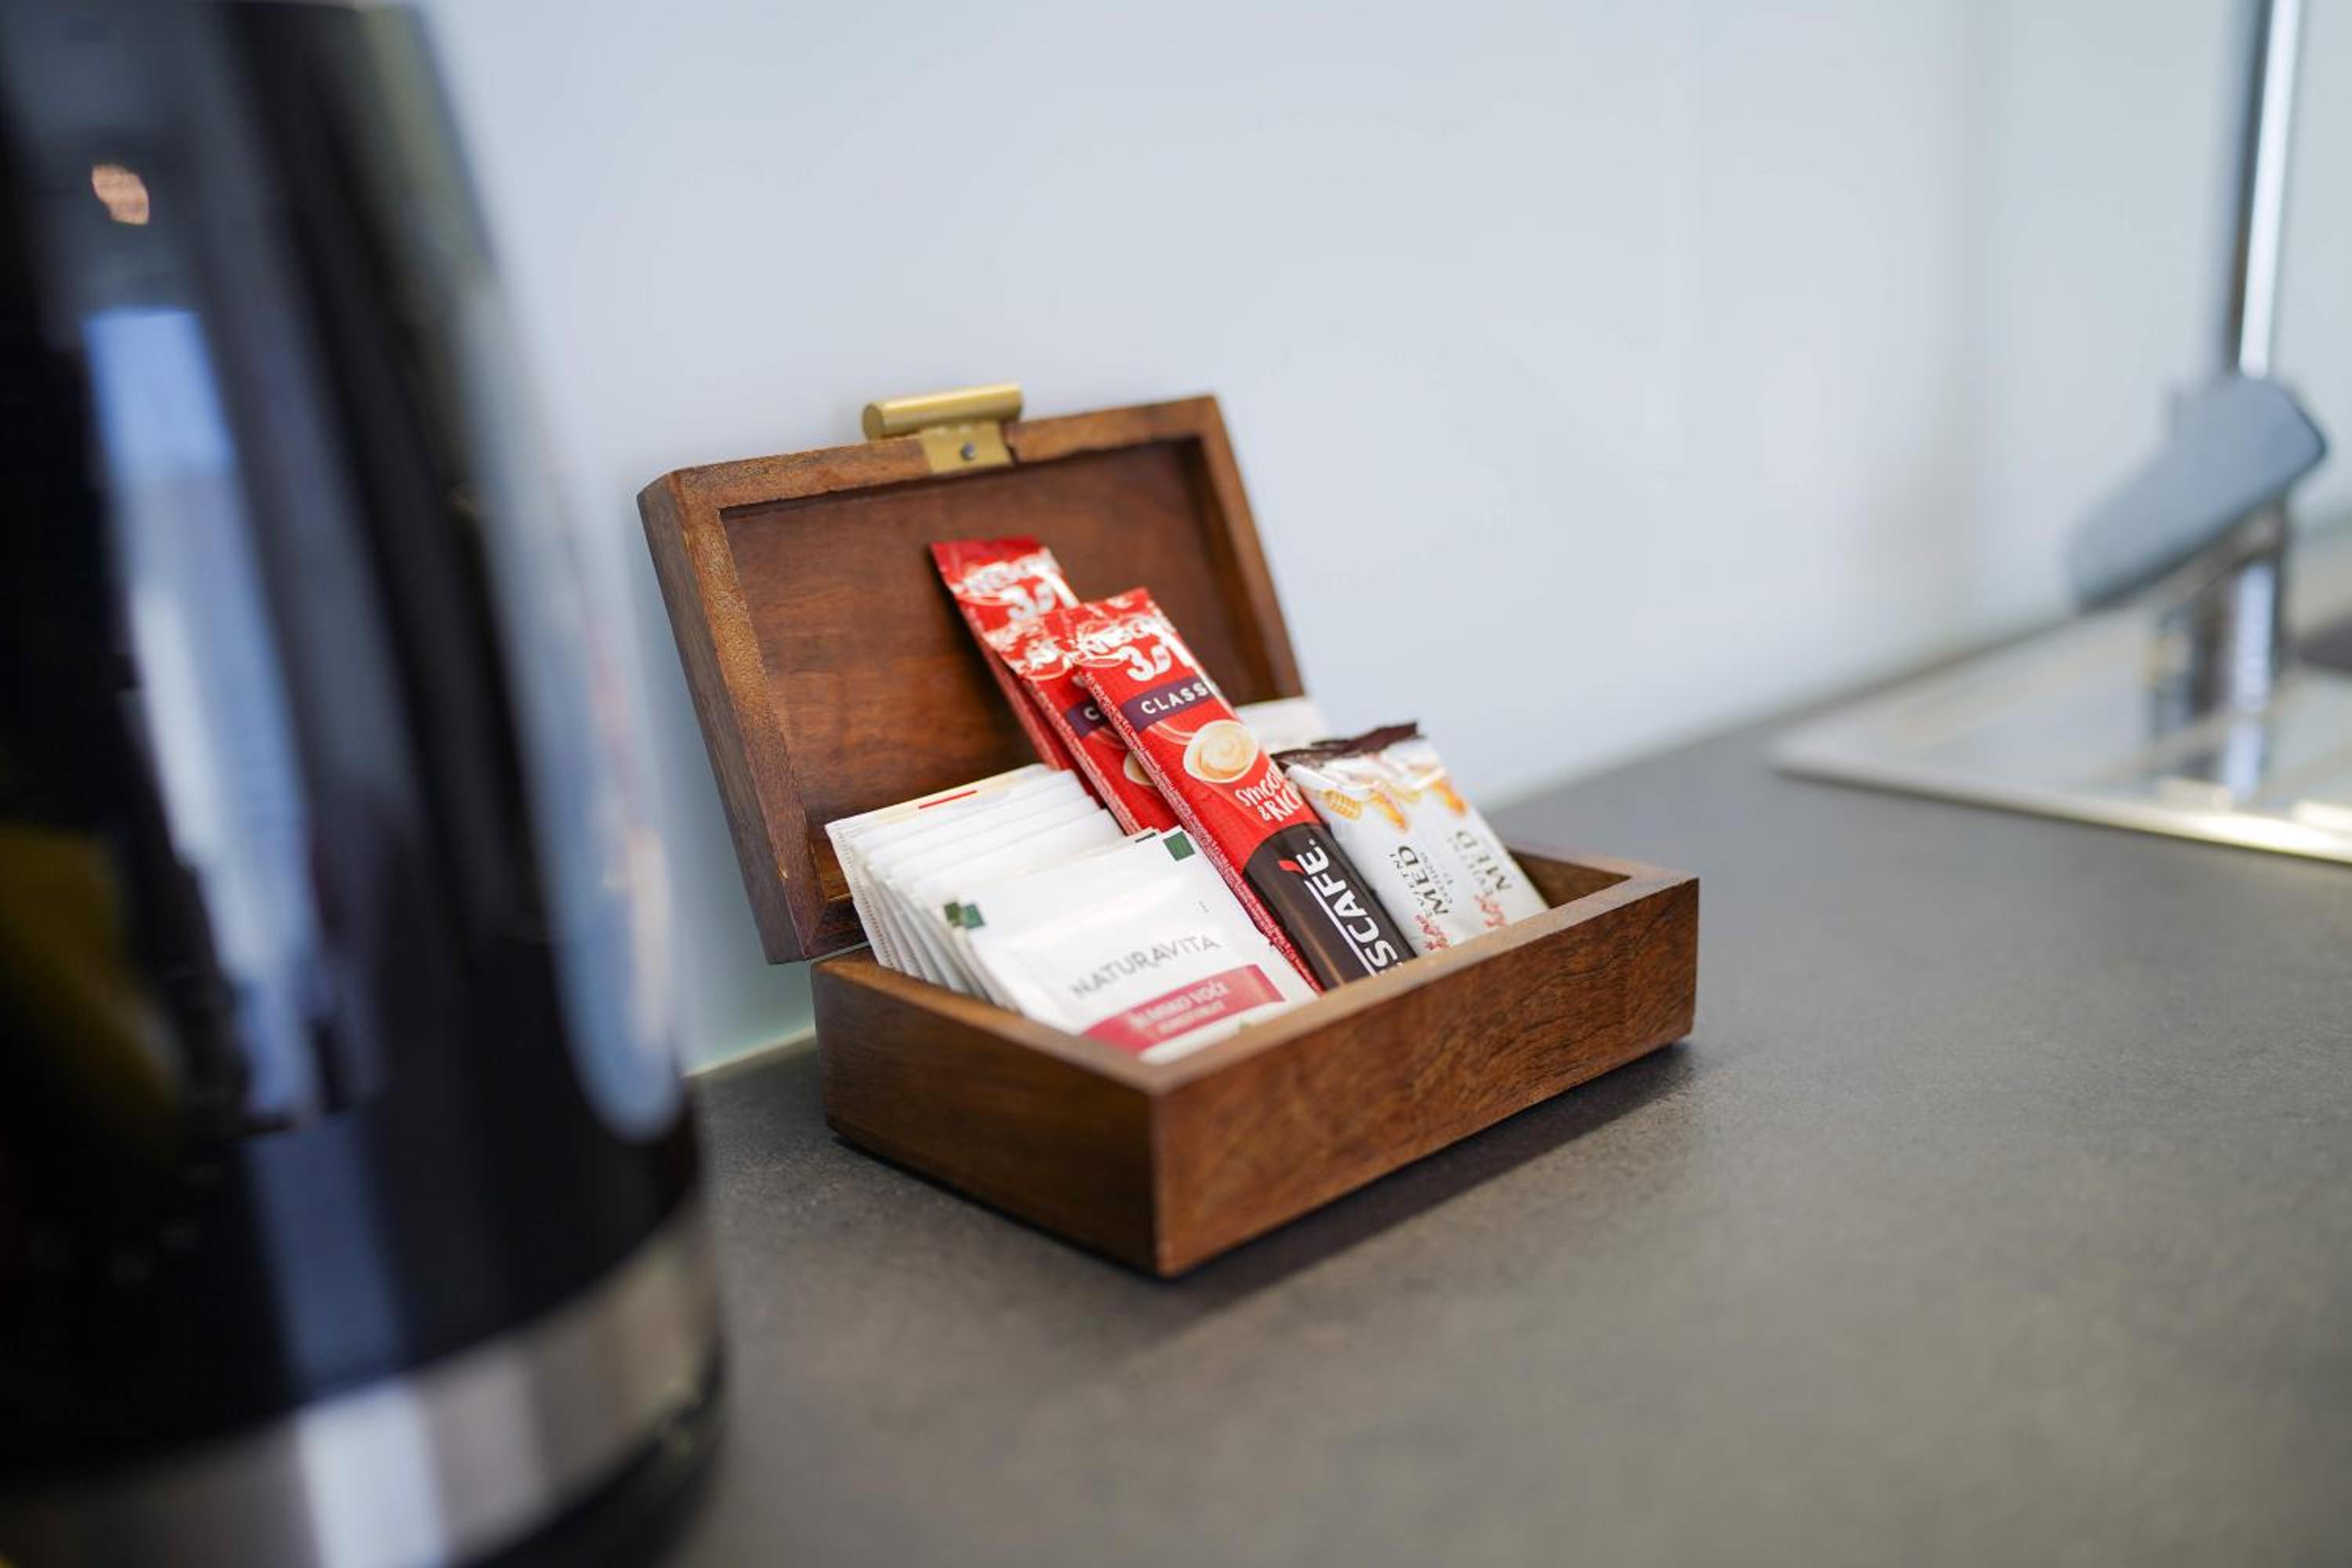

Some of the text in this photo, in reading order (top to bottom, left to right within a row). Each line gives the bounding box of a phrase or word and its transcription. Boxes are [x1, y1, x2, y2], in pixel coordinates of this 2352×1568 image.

[1283, 845, 1403, 969] SCAFÉ
[1397, 845, 1449, 916] MED
[1069, 935, 1221, 1000] NATURAVITA
